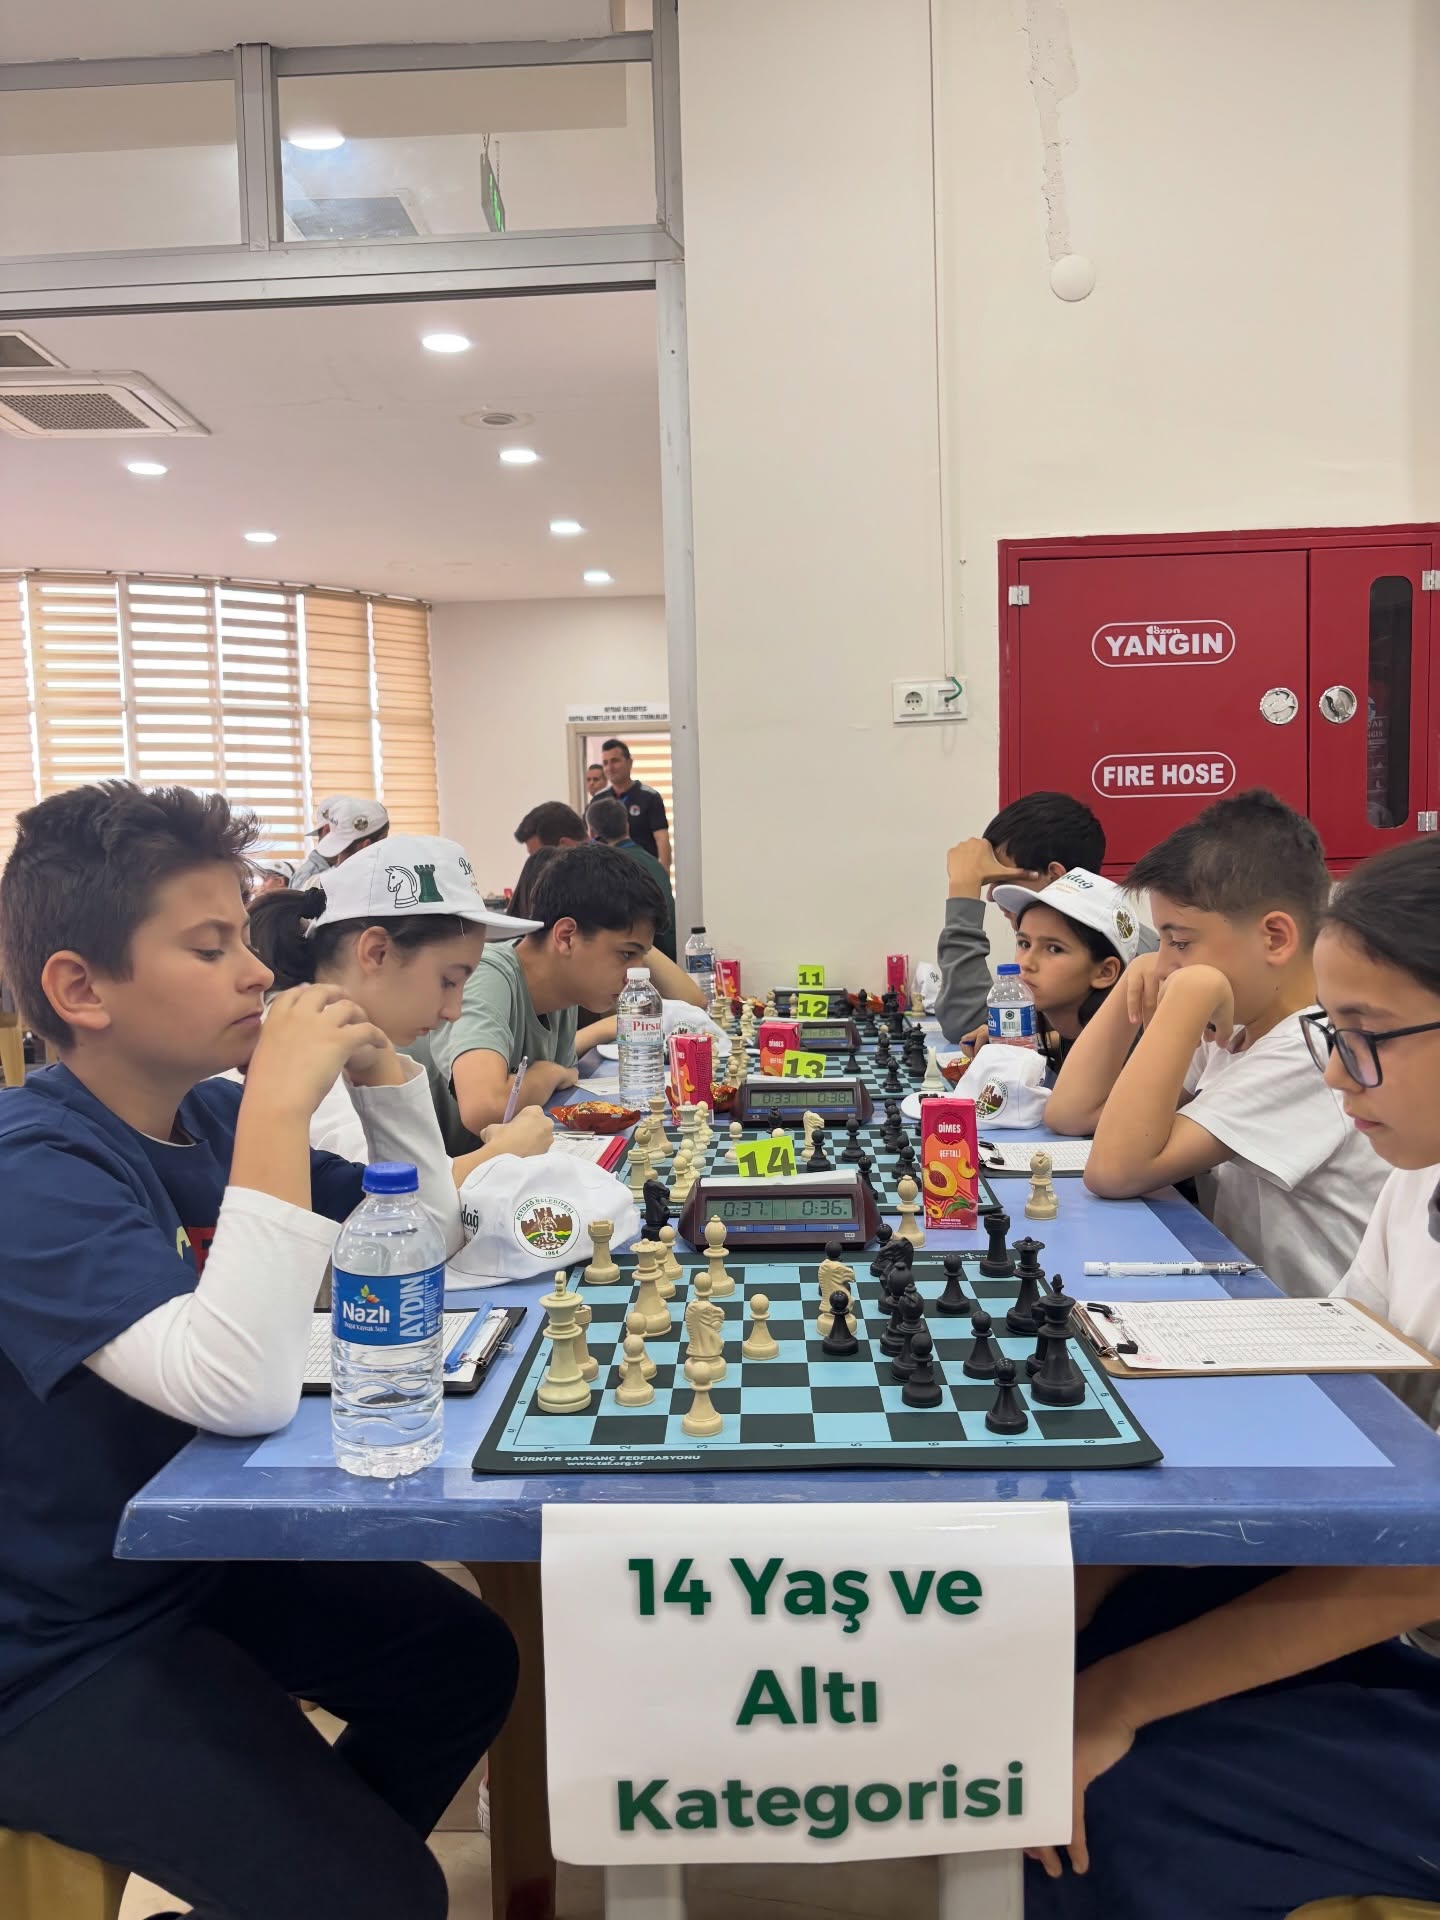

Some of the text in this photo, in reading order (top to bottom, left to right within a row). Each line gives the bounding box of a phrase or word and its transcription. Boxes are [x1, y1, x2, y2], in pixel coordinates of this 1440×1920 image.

[1104, 632, 1223, 657] YANGIN
[1103, 763, 1225, 787] FIRE HOSE
[799, 971, 823, 986] 11
[798, 999, 828, 1018] 12
[784, 1057, 824, 1079] 13
[938, 1121, 962, 1134] DİMES
[739, 1146, 796, 1177] 14
[342, 1301, 391, 1324] Nazlı
[400, 1275, 425, 1337] AYDIN
[627, 1557, 983, 1634] 14 Yaş ve
[735, 1666, 878, 1726] Altı
[617, 1760, 1025, 1840] Kategorisi
